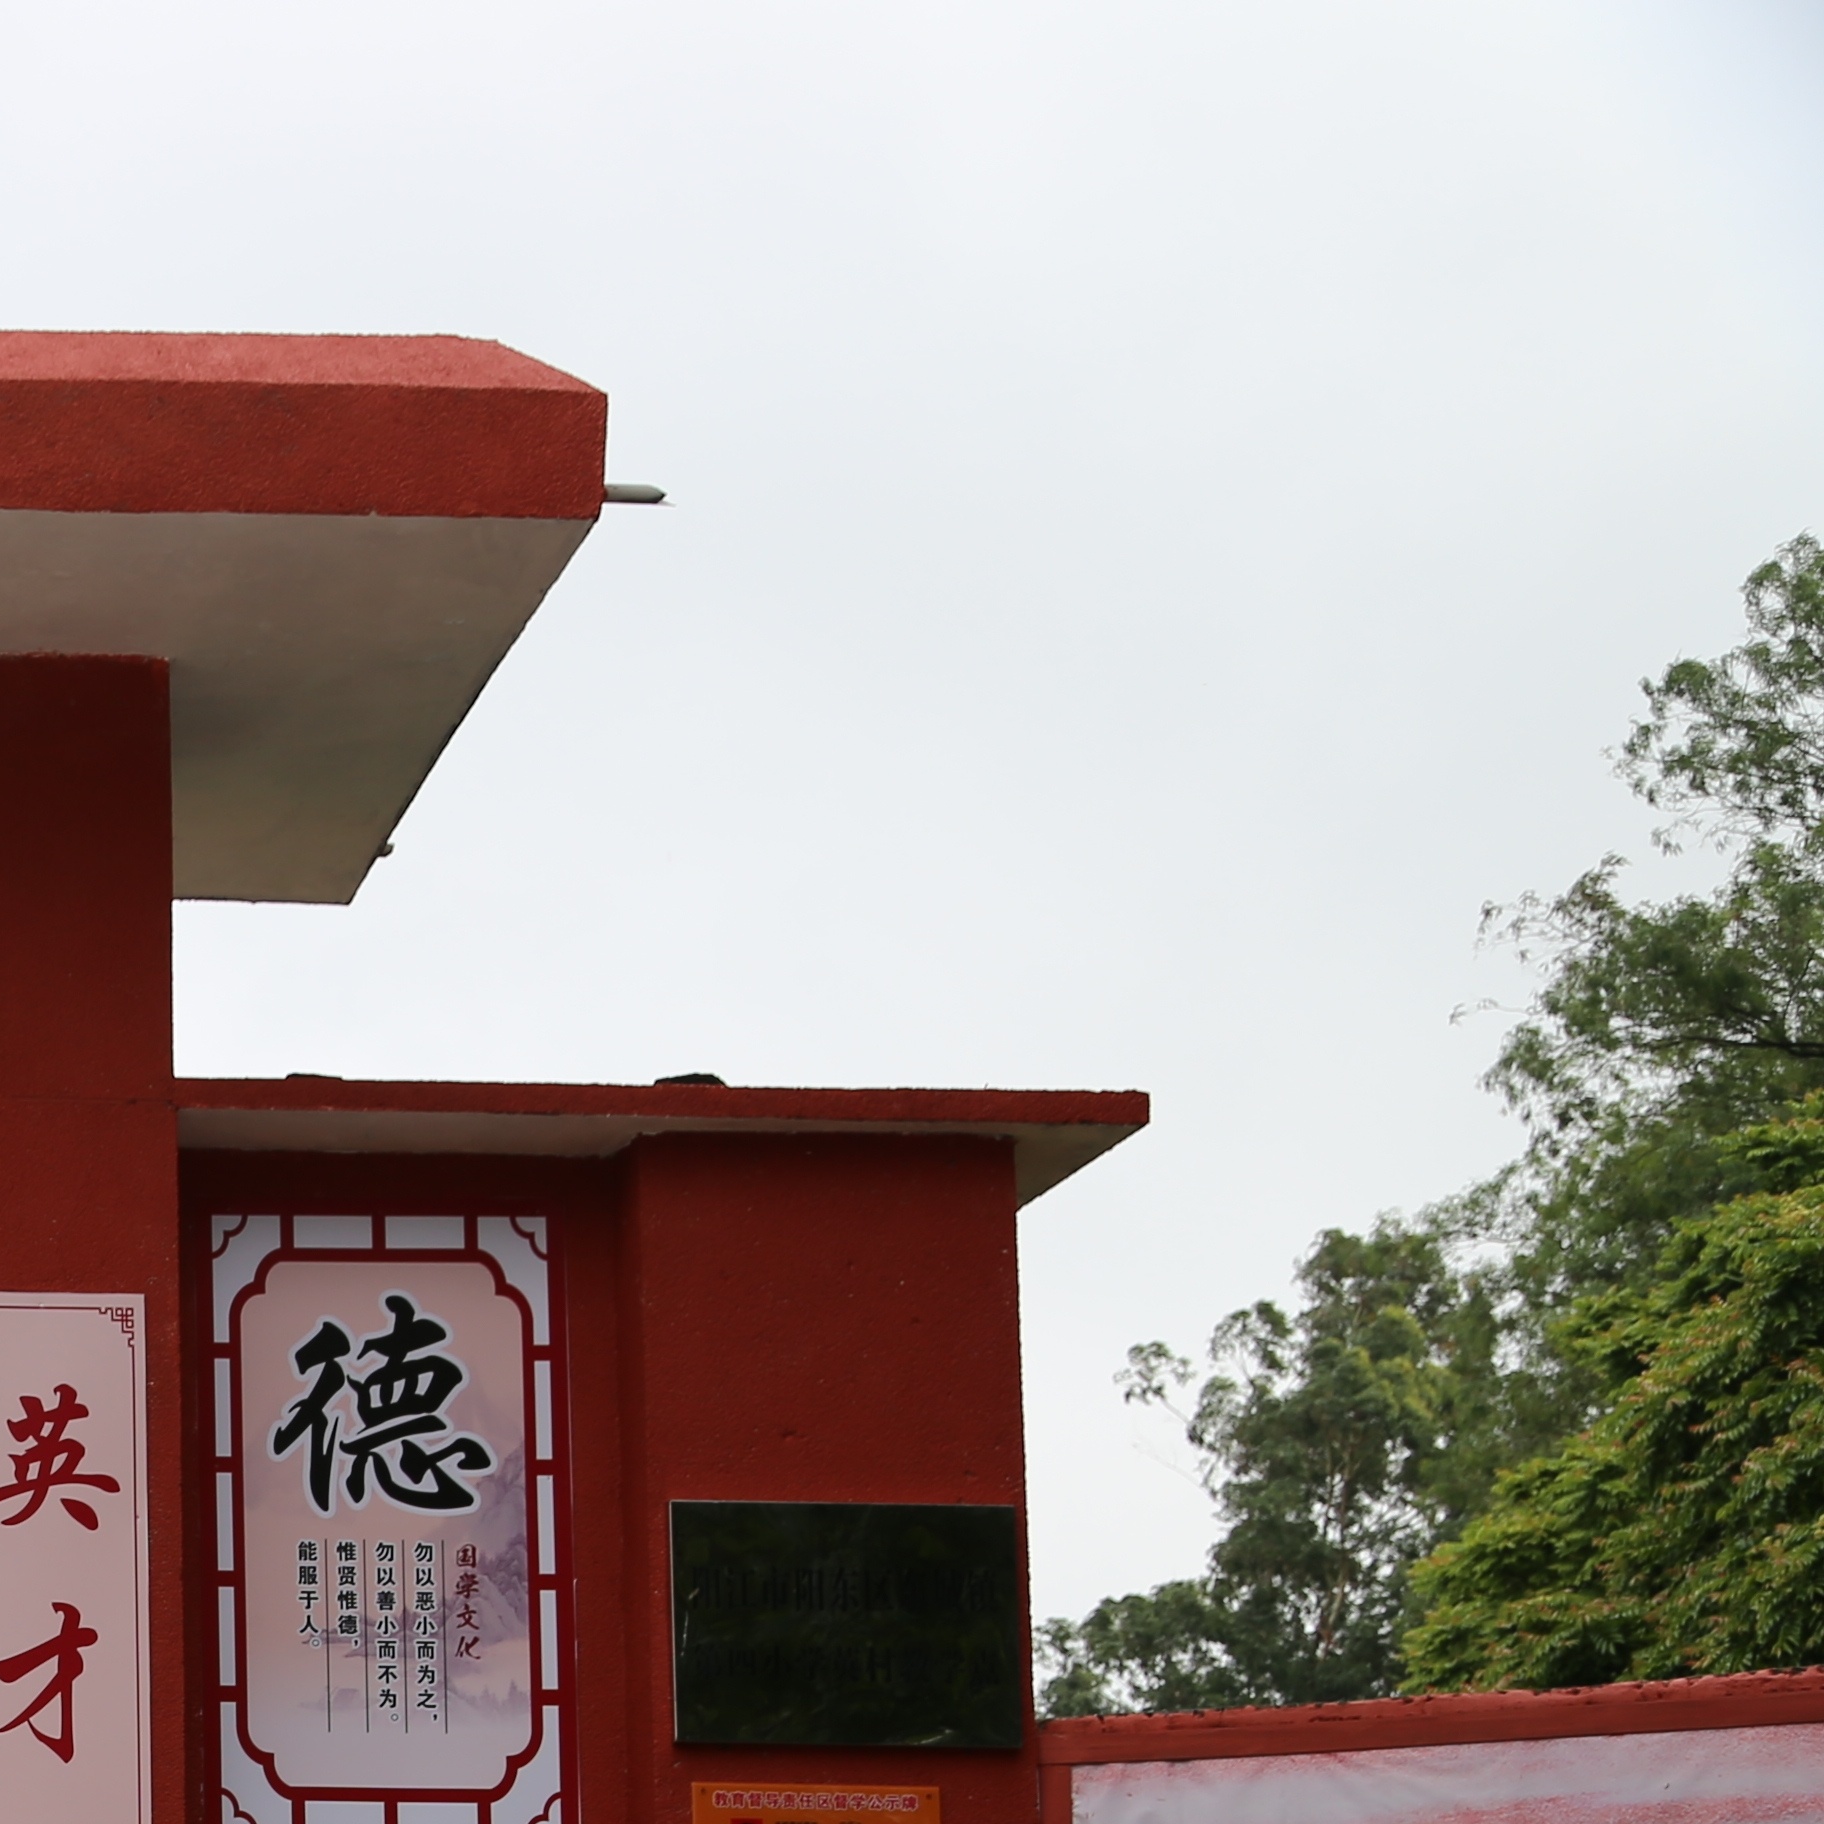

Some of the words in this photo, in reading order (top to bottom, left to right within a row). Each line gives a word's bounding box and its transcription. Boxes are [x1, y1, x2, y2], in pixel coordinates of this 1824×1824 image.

[272, 1294, 493, 1512] 德
[297, 1540, 321, 1650] 能服于人。
[336, 1540, 360, 1649] 惟贤惟德，
[375, 1540, 399, 1724] 勿以善小而不为。
[412, 1540, 440, 1722] 勿以恶小而为之，
[453, 1543, 482, 1662] 国学文化
